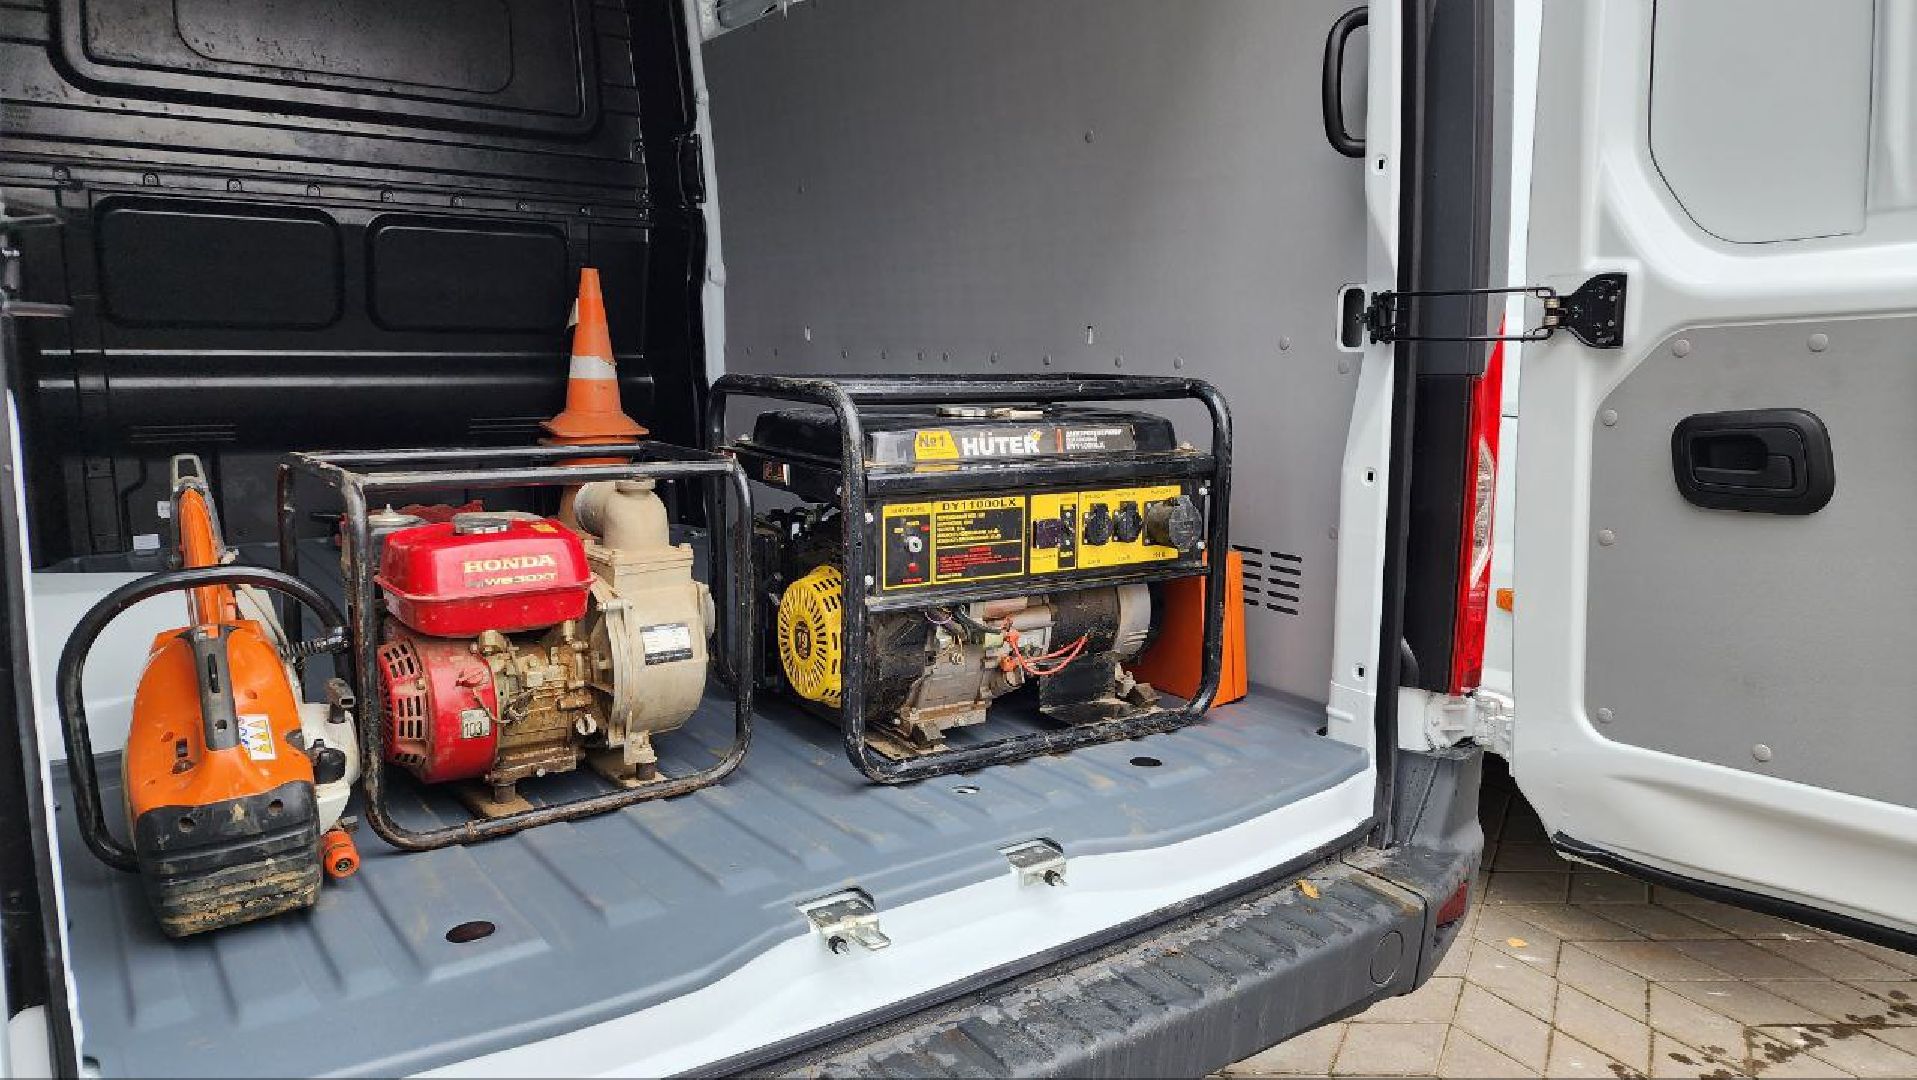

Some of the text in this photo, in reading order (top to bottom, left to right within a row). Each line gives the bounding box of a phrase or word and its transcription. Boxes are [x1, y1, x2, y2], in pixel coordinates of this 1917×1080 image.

[961, 431, 1041, 456] HÜTER
[942, 498, 1017, 511] DY11000LX
[464, 554, 556, 573] HONDA
